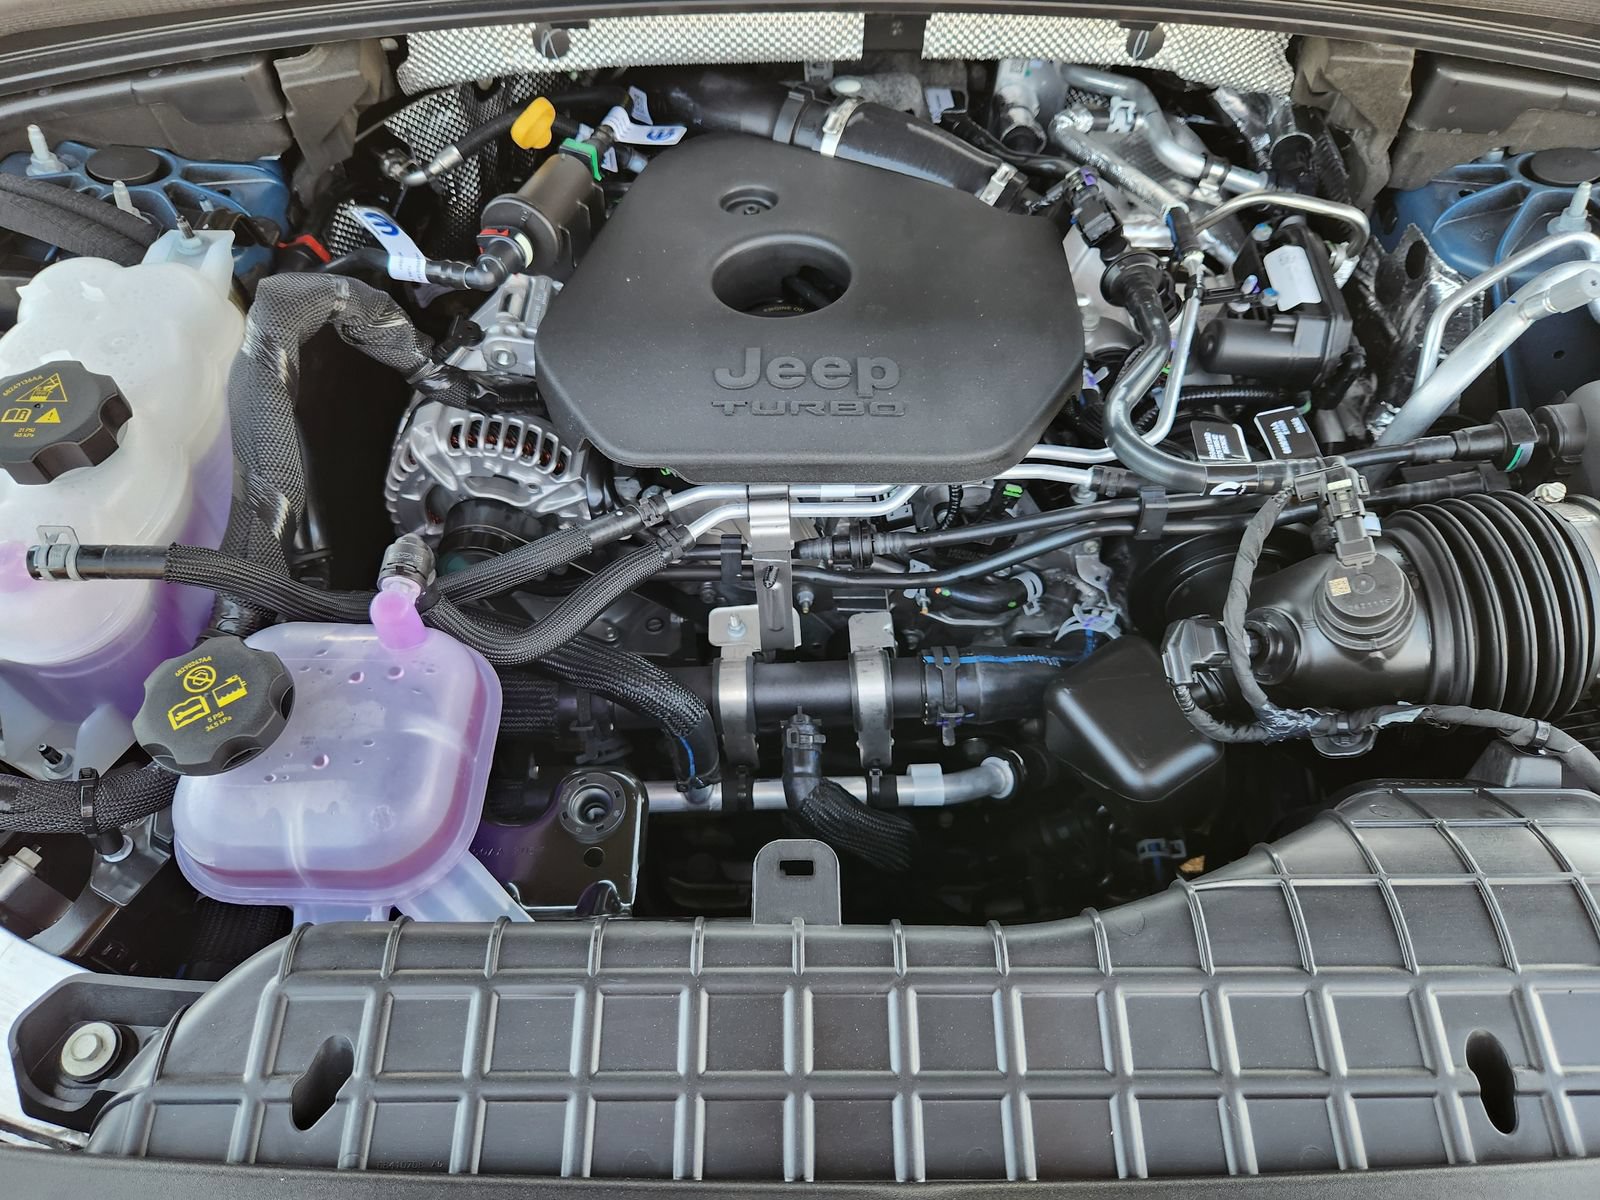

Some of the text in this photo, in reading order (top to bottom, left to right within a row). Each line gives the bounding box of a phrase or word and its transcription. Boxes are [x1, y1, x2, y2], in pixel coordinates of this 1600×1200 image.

[713, 347, 900, 399] Jeep
[711, 400, 905, 417] TURBO
[212, 711, 225, 721] PSI
